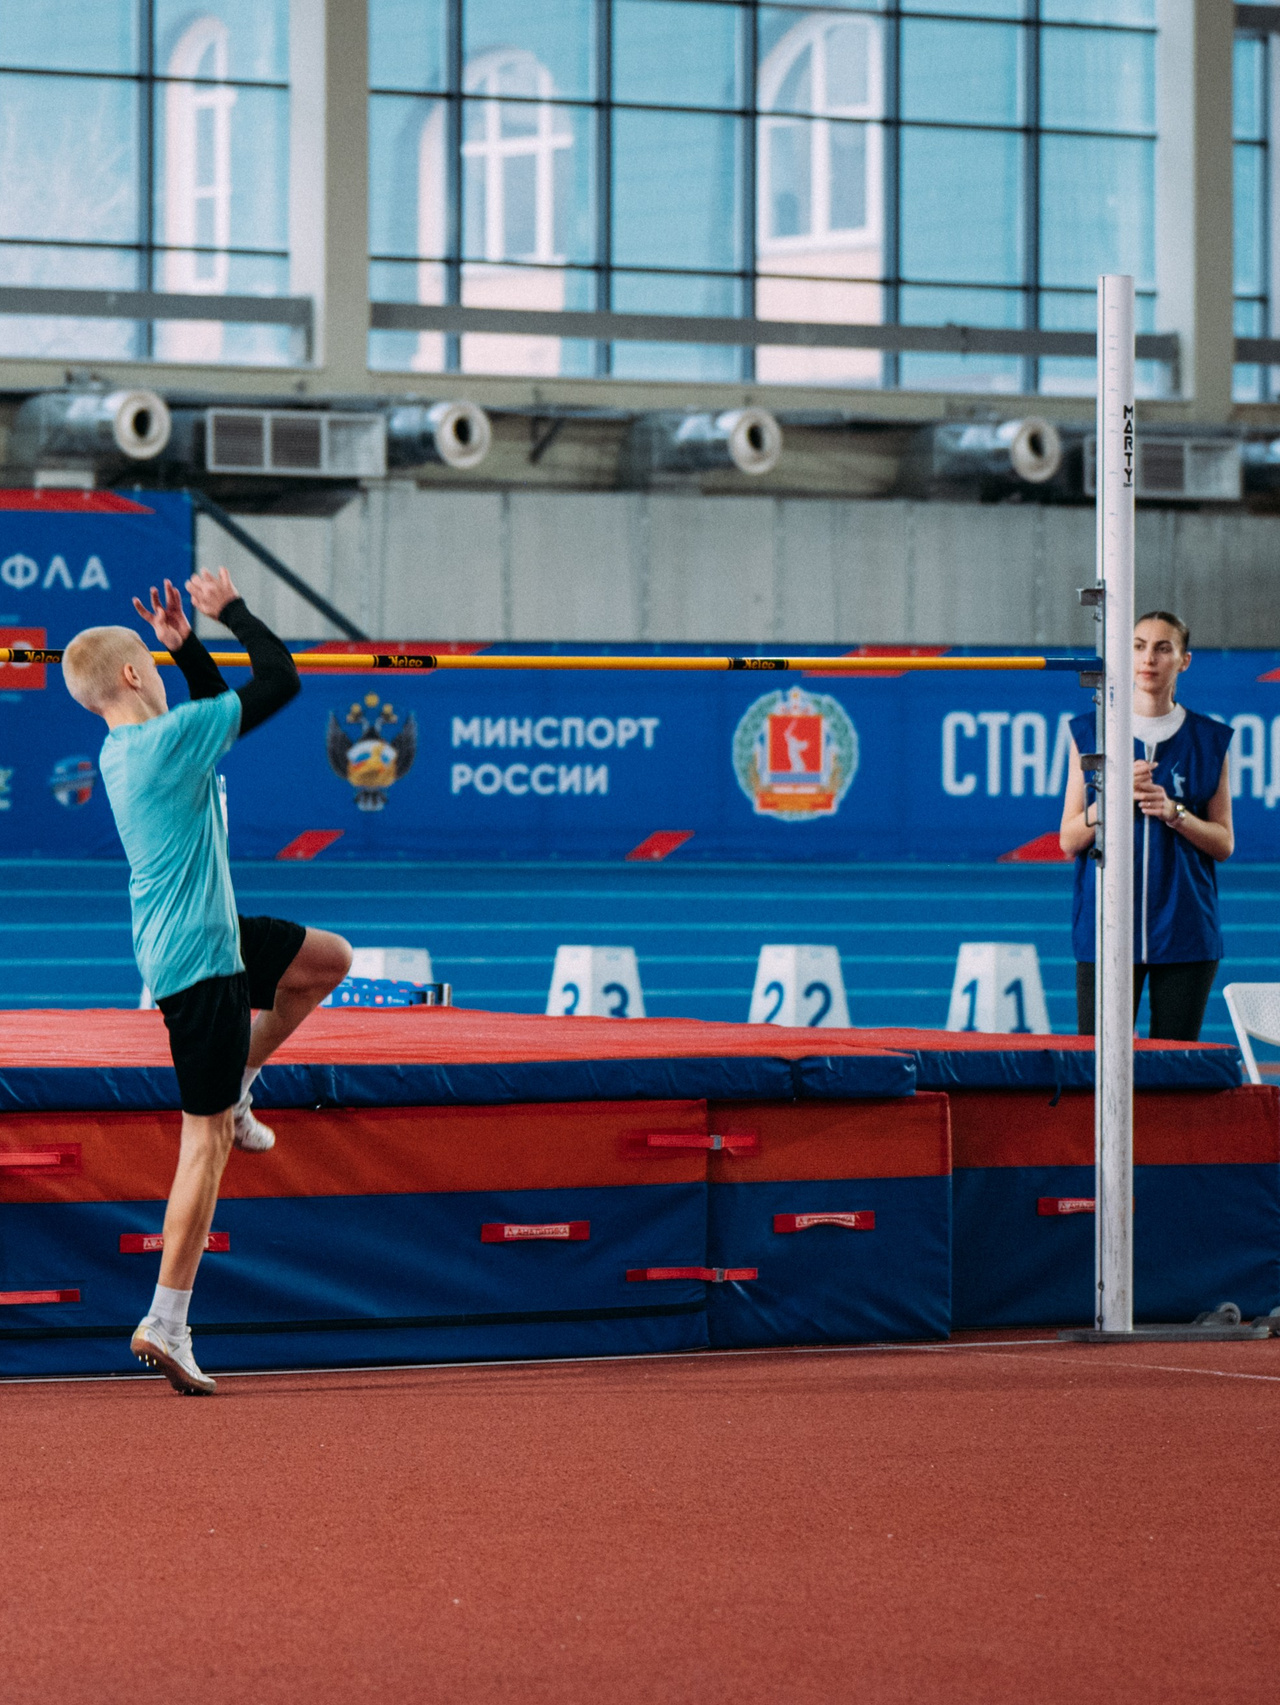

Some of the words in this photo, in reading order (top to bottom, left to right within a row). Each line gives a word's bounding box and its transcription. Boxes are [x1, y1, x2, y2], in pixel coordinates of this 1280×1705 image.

[1123, 404, 1133, 482] MARTY
[24, 651, 60, 663] Nelco
[388, 655, 423, 667] Nelco
[451, 717, 659, 748] МИНСПОРТ
[451, 763, 608, 794] РОССИИ
[764, 981, 784, 1023] 2
[804, 982, 832, 1027] 2
[962, 978, 978, 1031] 1
[1004, 977, 1032, 1034] 1
